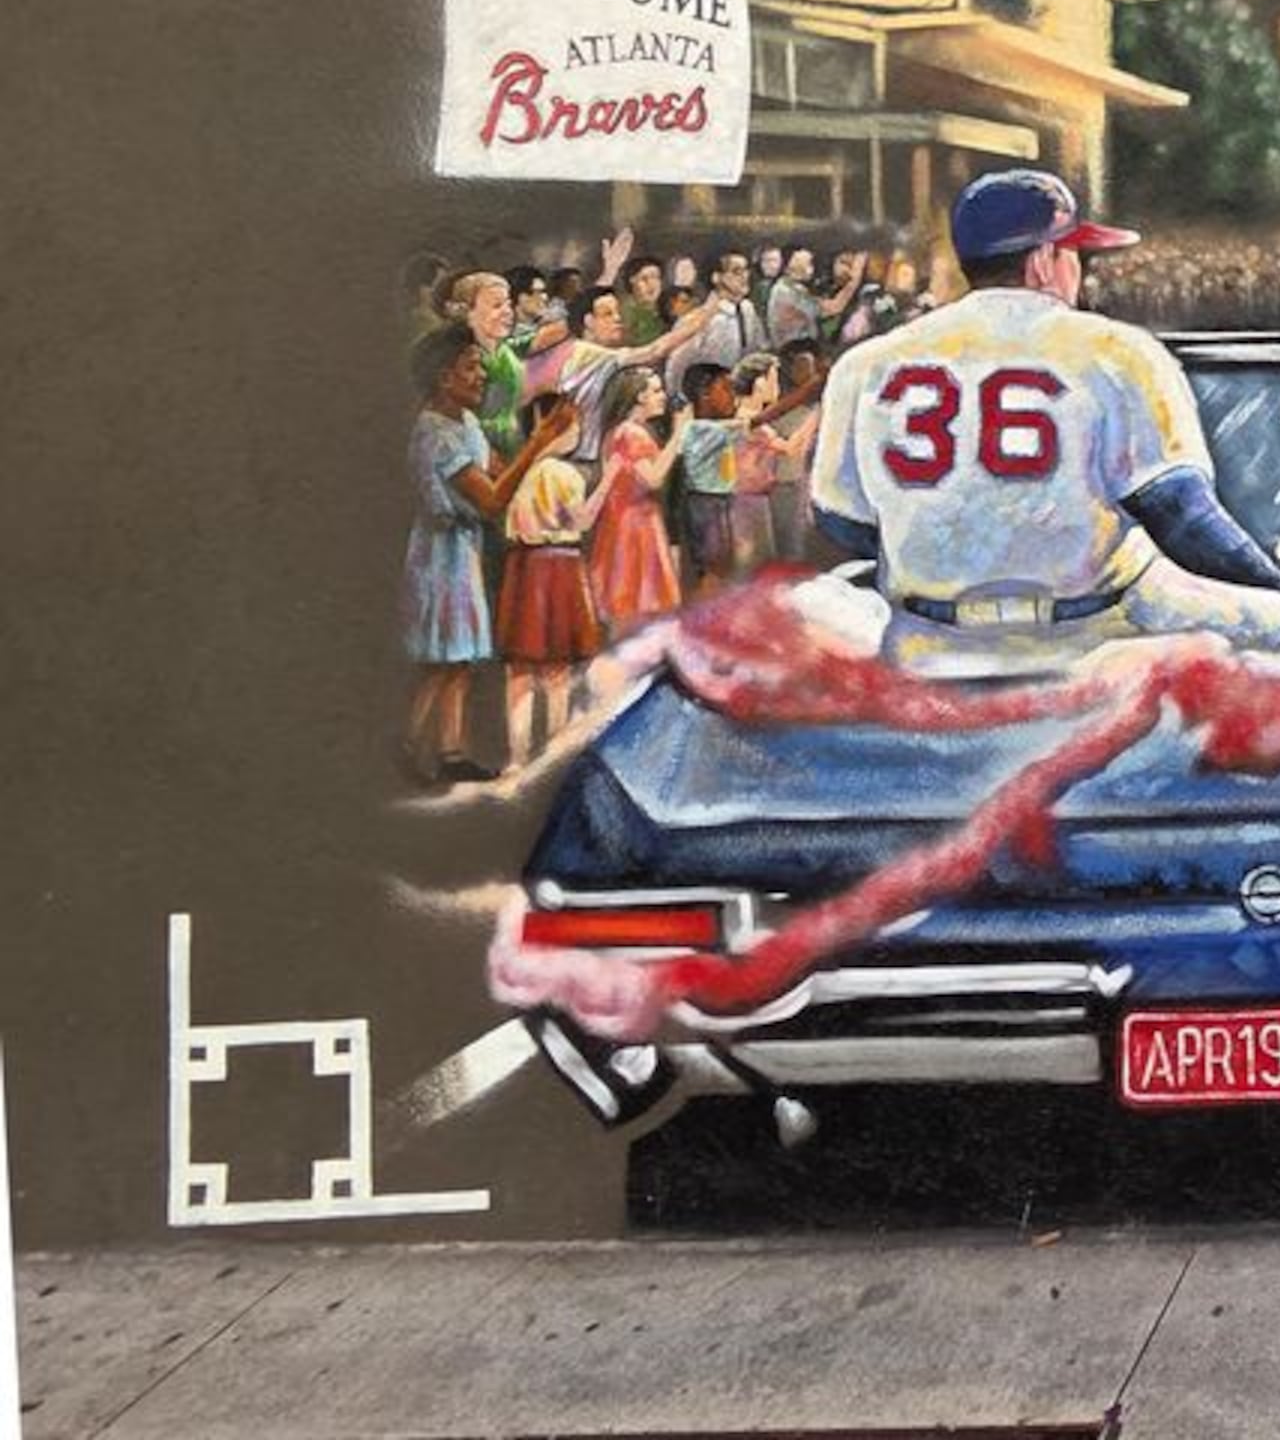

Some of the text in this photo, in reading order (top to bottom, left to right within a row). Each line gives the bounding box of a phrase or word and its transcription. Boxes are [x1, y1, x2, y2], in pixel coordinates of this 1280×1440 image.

[479, 50, 709, 149] Braves
[564, 31, 718, 75] ATLANTA
[877, 362, 1072, 491] 36
